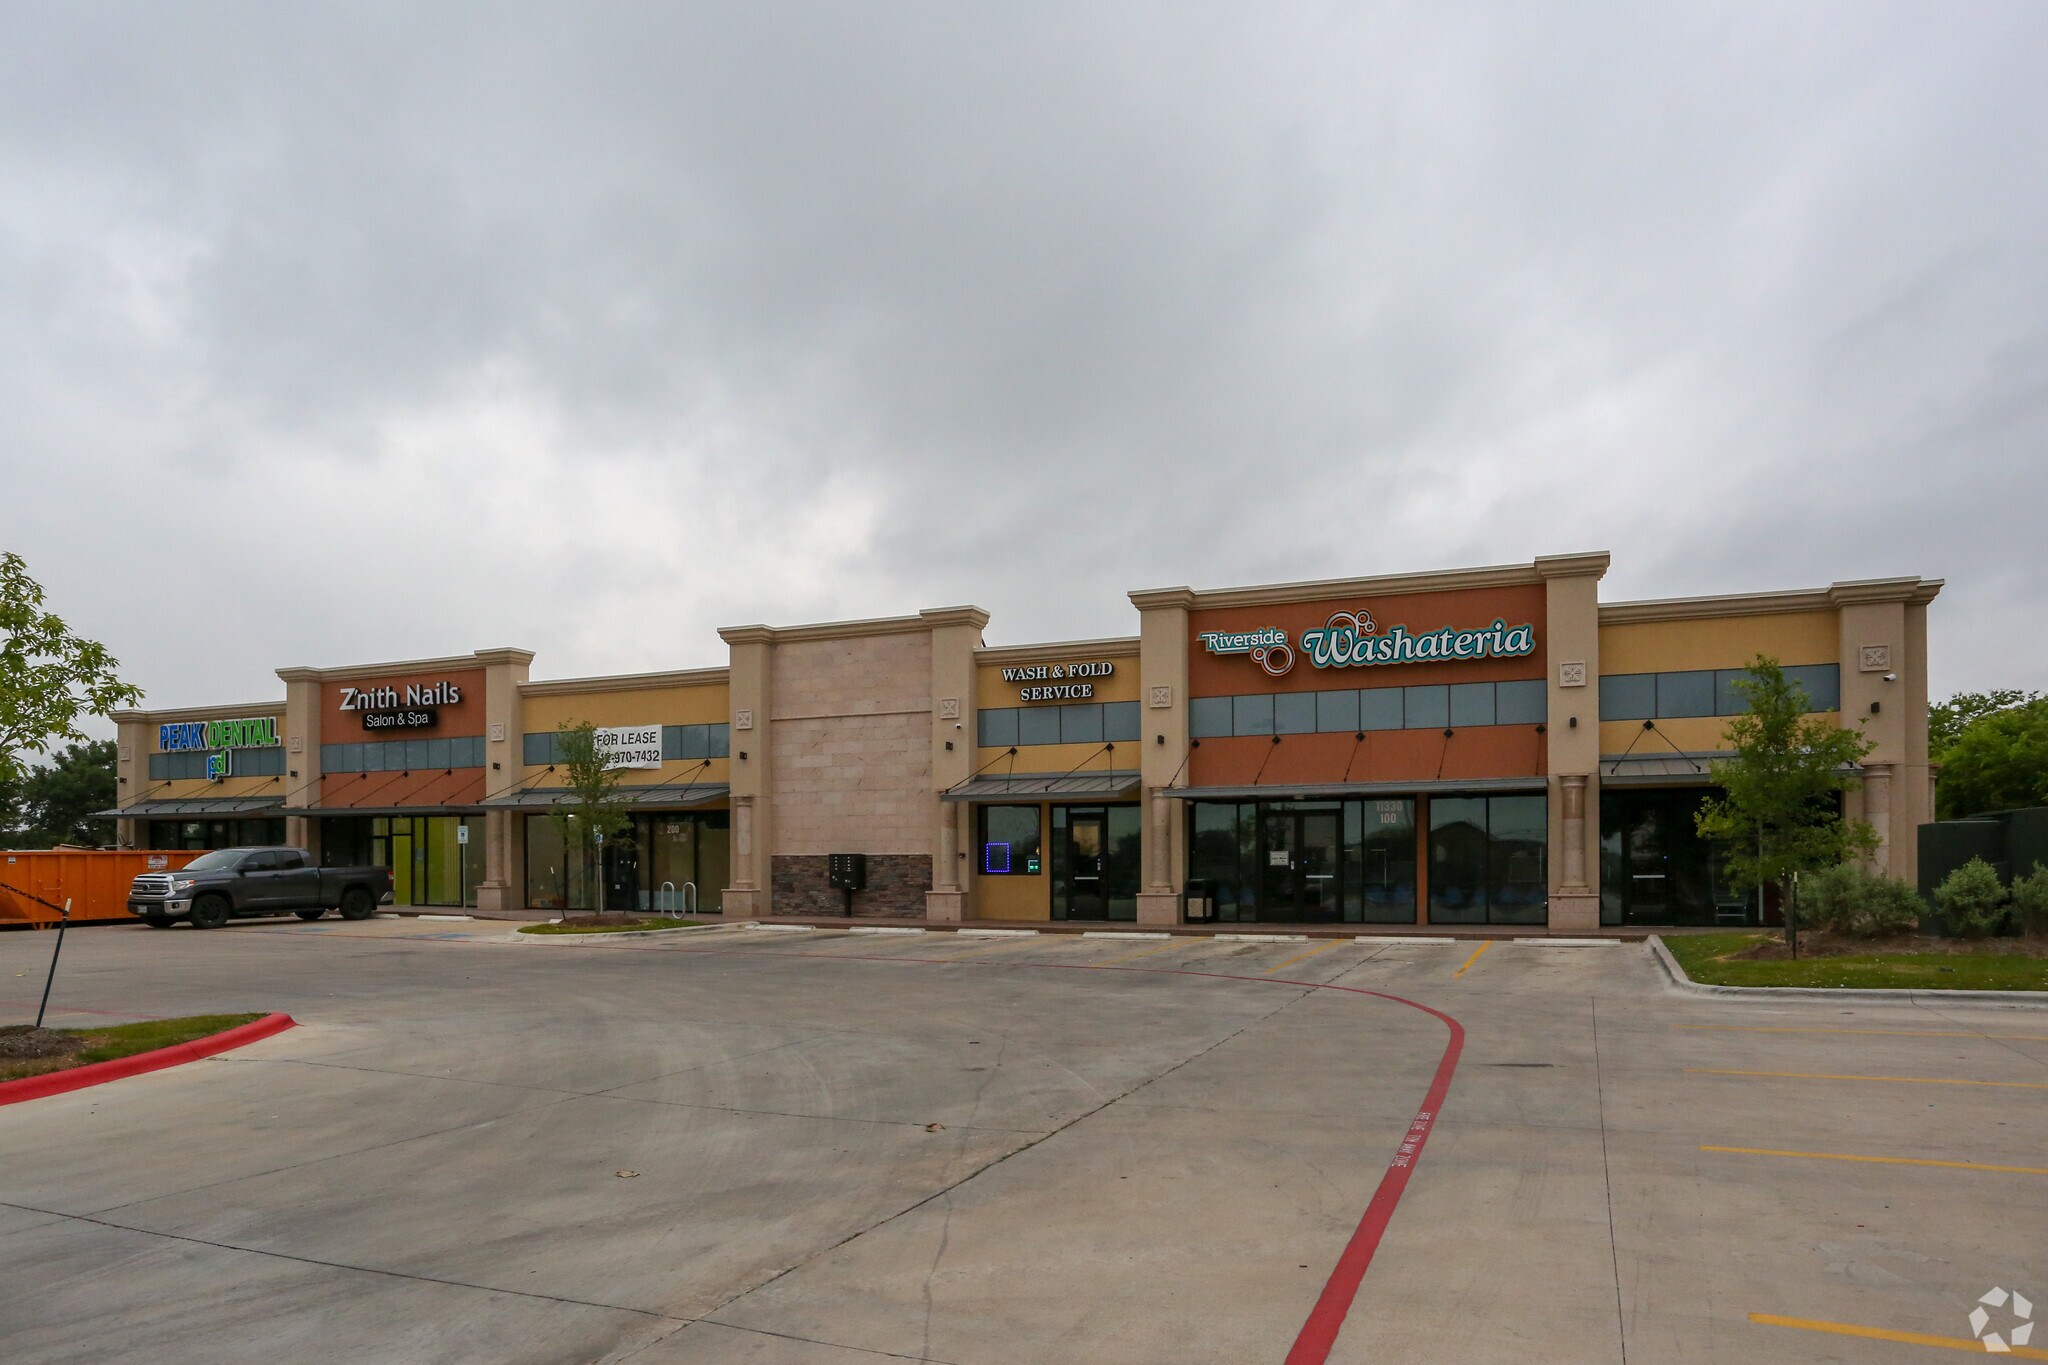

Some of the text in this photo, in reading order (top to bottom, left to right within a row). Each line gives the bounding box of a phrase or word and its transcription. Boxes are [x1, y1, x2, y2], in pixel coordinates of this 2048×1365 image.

[1201, 627, 1285, 651] Riverside
[1304, 621, 1532, 664] Washateria
[1002, 661, 1113, 682] WASH & FOLD
[406, 681, 460, 707] Nails
[1020, 684, 1093, 701] SERVICE
[366, 711, 429, 728] Salon & Spa
[159, 717, 279, 752] PEAK DENTAL
[597, 731, 657, 746] FOR LEASE
[1381, 813, 1397, 824] 100
[667, 824, 680, 834] 200
